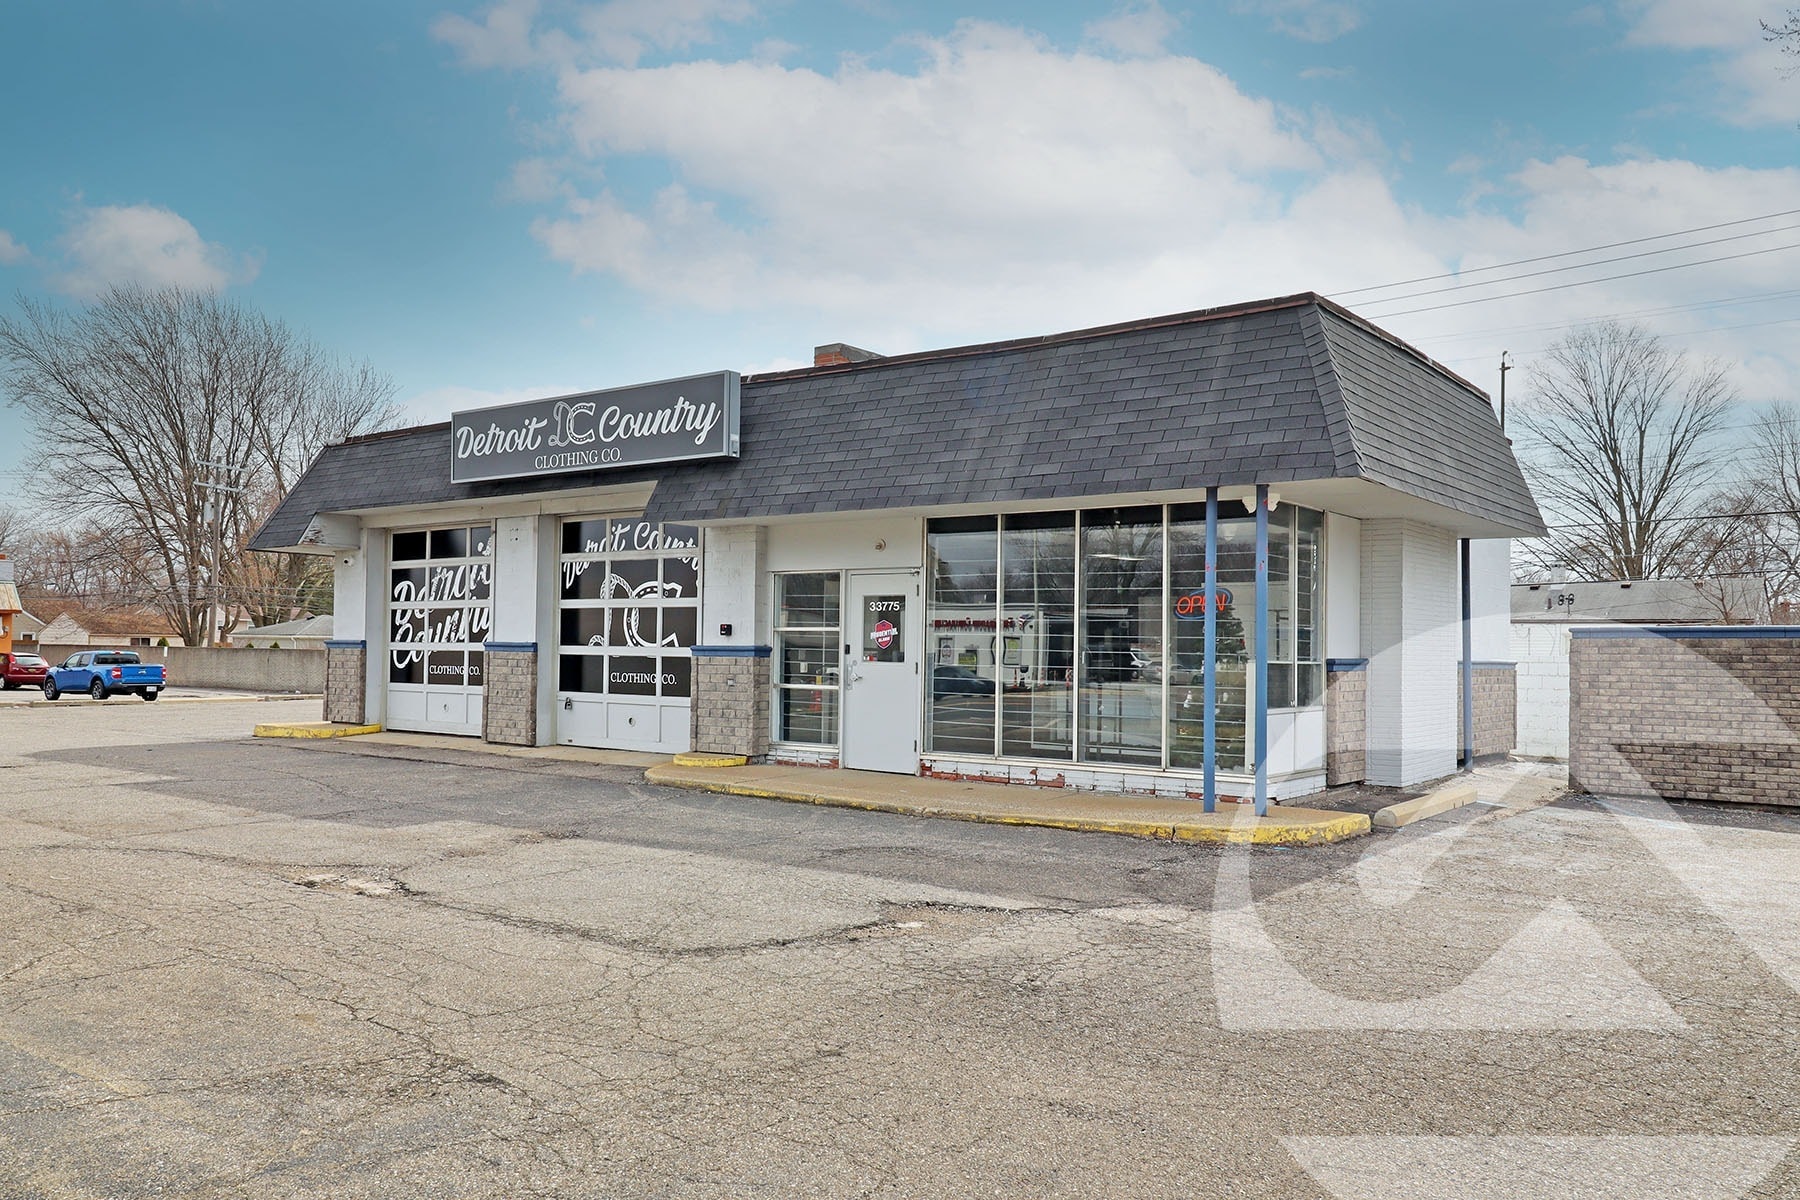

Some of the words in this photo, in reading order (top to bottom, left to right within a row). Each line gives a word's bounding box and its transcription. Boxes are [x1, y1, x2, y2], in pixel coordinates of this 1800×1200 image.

[456, 417, 548, 460] Detroit
[599, 396, 722, 445] Country
[535, 449, 598, 470] CLOTHING
[601, 447, 622, 462] CO.
[869, 601, 900, 612] 33775
[1177, 594, 1227, 614] OPN
[429, 665, 464, 675] CLOTHING
[468, 666, 481, 676] CO.
[610, 672, 657, 684] CLOTHING
[661, 674, 677, 685] CO.
